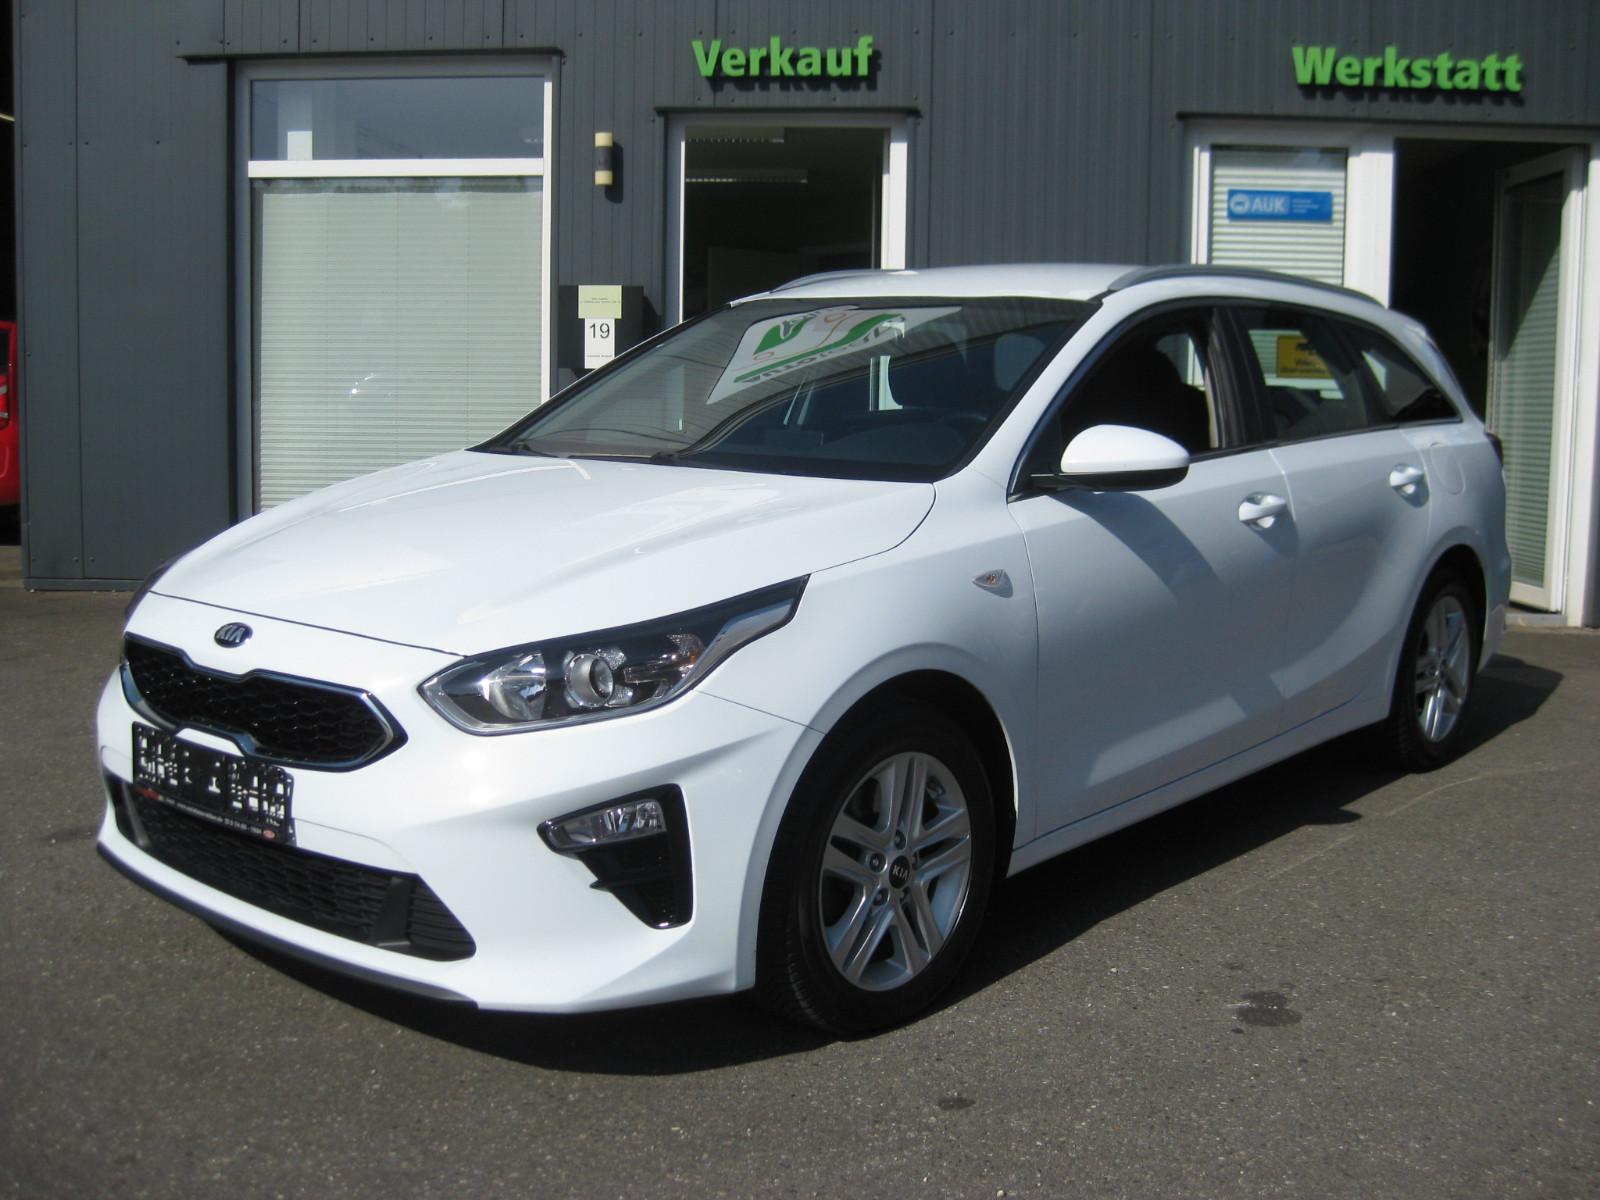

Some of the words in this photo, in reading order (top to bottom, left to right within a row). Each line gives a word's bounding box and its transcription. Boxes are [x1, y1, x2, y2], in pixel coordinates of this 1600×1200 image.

[691, 35, 874, 78] Verkauf
[1292, 45, 1524, 93] Werkstatt
[589, 322, 611, 339] 19
[215, 624, 247, 643] KIA
